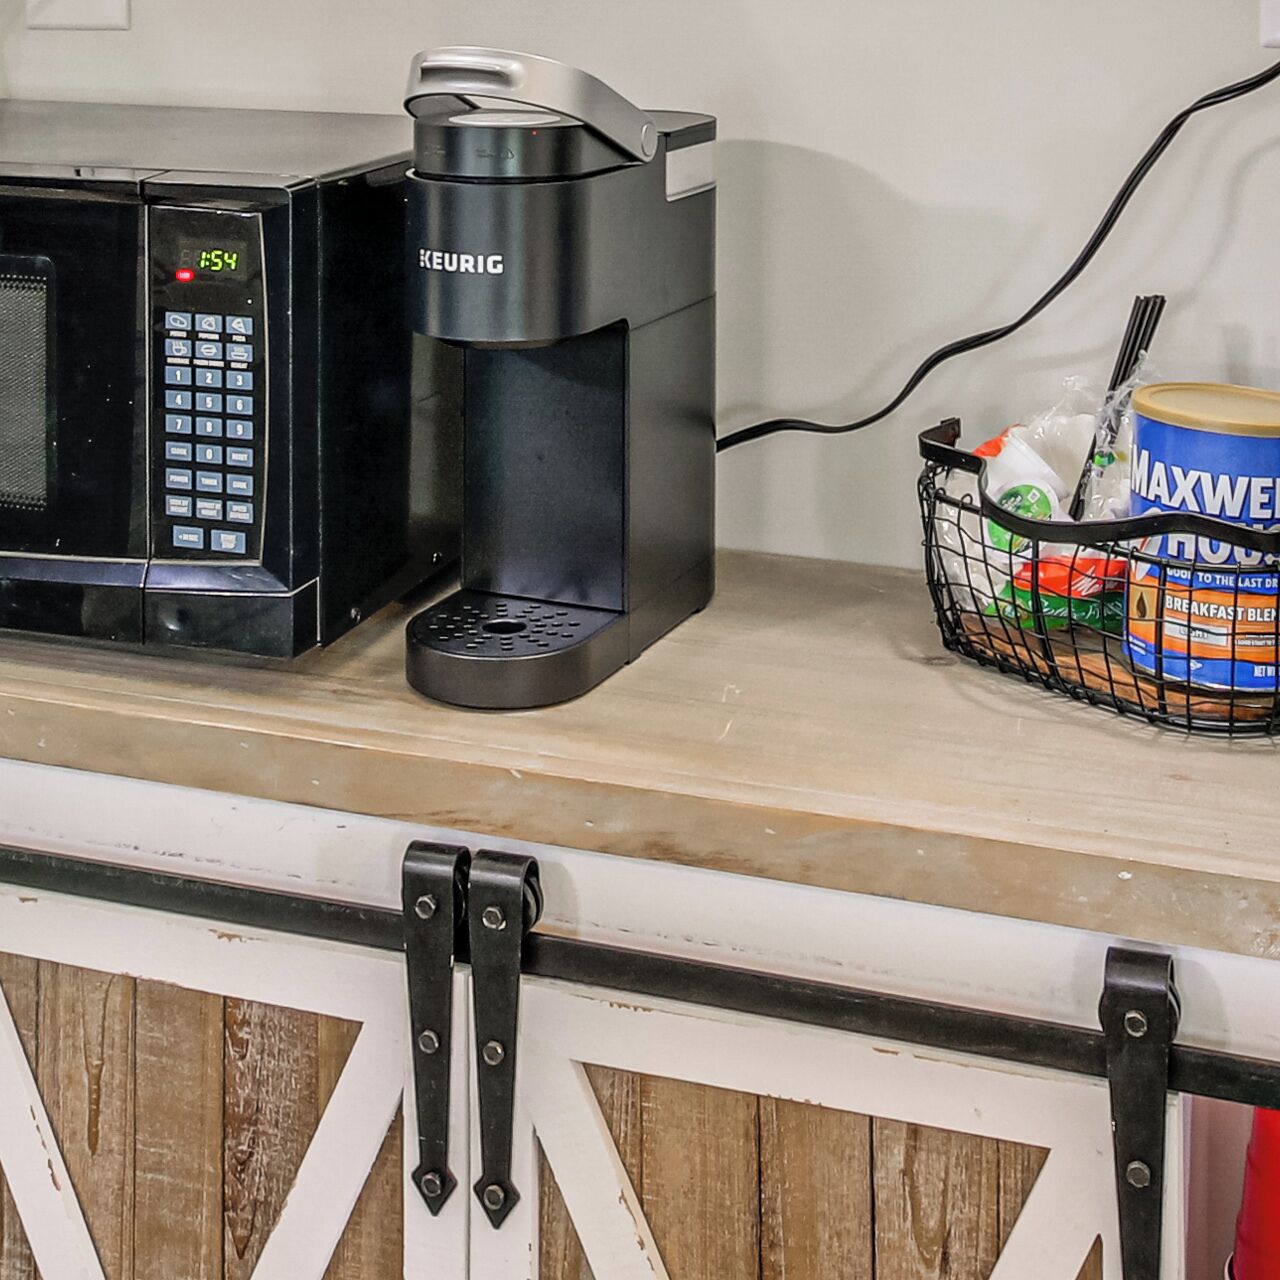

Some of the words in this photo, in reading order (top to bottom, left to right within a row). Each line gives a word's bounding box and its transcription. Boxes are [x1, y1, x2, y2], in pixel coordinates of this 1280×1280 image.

[200, 250, 237, 271] 1:54
[419, 249, 504, 274] KEURIG
[176, 370, 181, 381] 1
[205, 372, 213, 384] 2
[236, 375, 243, 386] 3
[175, 394, 182, 405] 4
[205, 396, 213, 408] 5
[236, 399, 243, 411] 6
[175, 419, 182, 430] 7
[206, 421, 213, 433] 8
[236, 424, 243, 436] 9
[206, 448, 213, 460] 0
[1197, 572, 1212, 584] TO
[1215, 574, 1235, 586] THE
[1238, 577, 1263, 589] LAST
[1166, 595, 1245, 621] BREAKFAST
